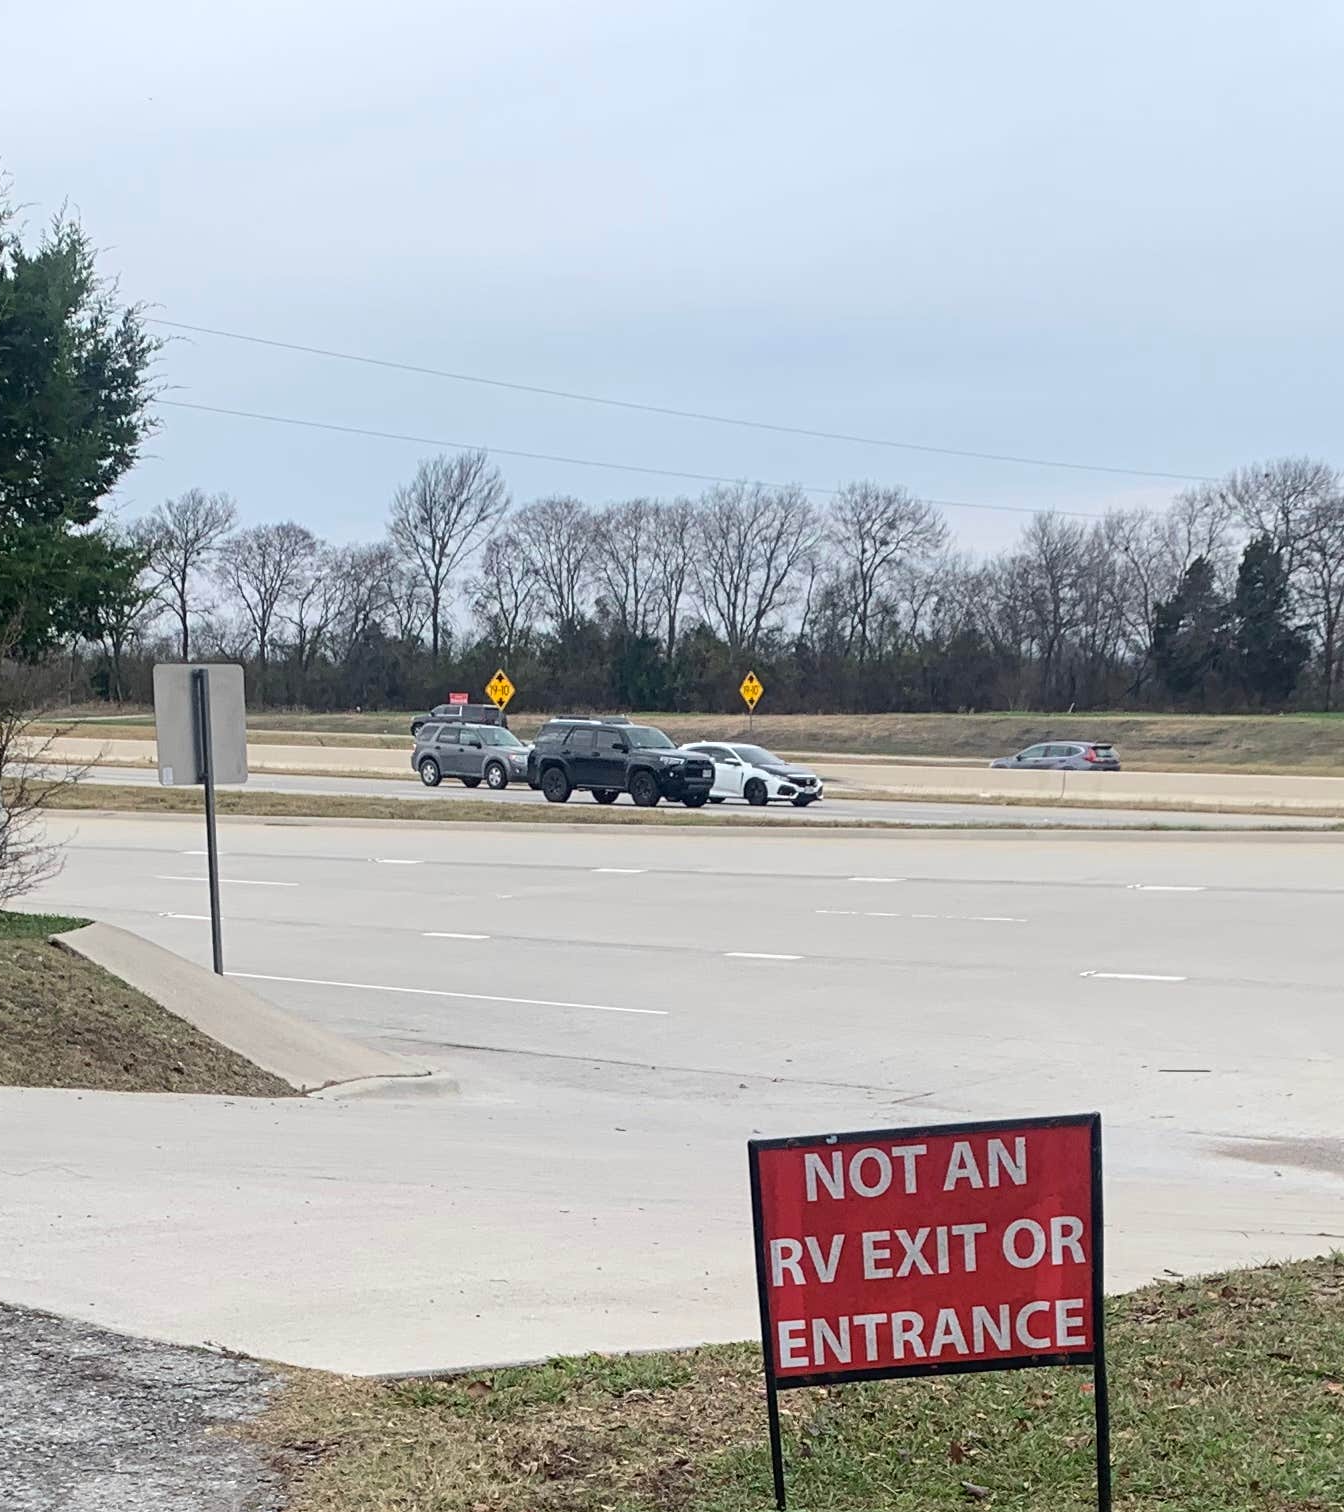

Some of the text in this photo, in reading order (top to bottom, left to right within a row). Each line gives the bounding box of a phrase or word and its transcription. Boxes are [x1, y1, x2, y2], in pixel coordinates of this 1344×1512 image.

[804, 1136, 1027, 1201] NOT AN
[770, 1216, 1086, 1287] RV EXIT OR
[777, 1298, 1086, 1368] ENTRANCE
